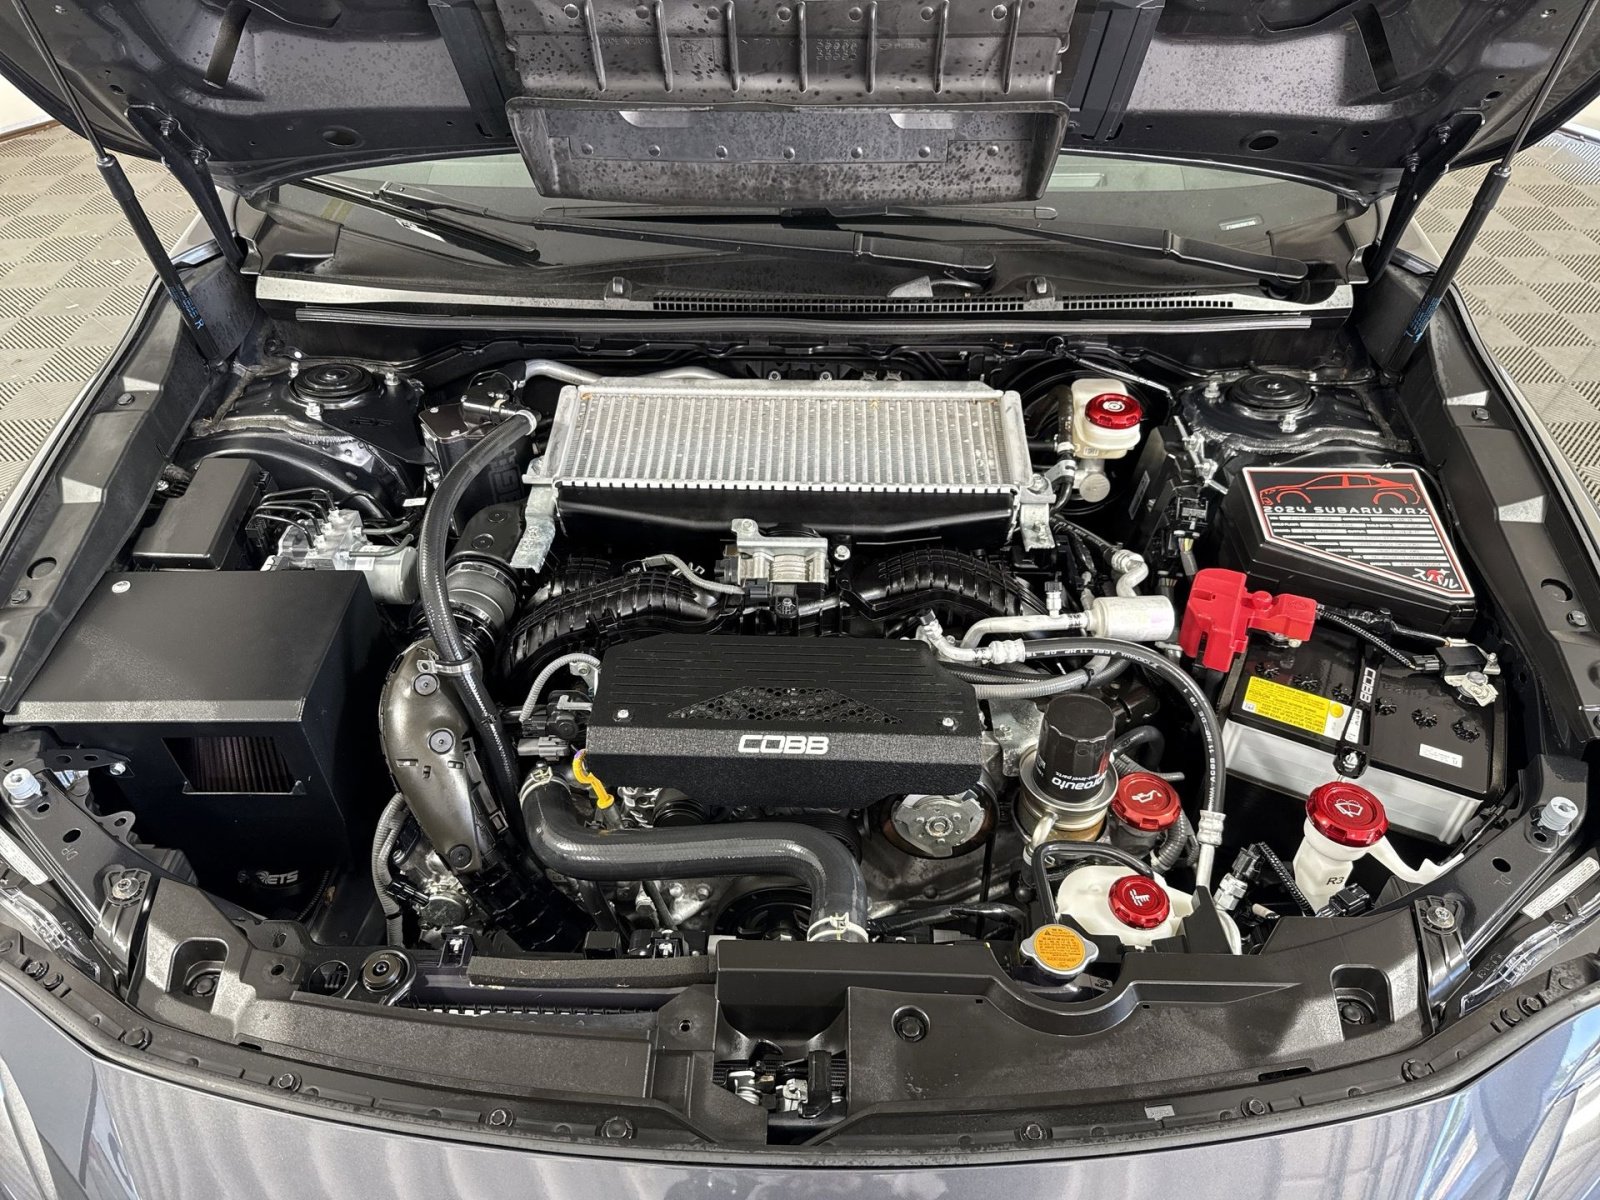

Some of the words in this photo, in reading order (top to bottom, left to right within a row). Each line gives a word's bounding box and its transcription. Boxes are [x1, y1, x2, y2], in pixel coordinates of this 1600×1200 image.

[1314, 506, 1383, 514] SUBARU
[1360, 668, 1377, 704] COBB
[738, 734, 829, 755] COBB
[1326, 876, 1345, 886] R3
